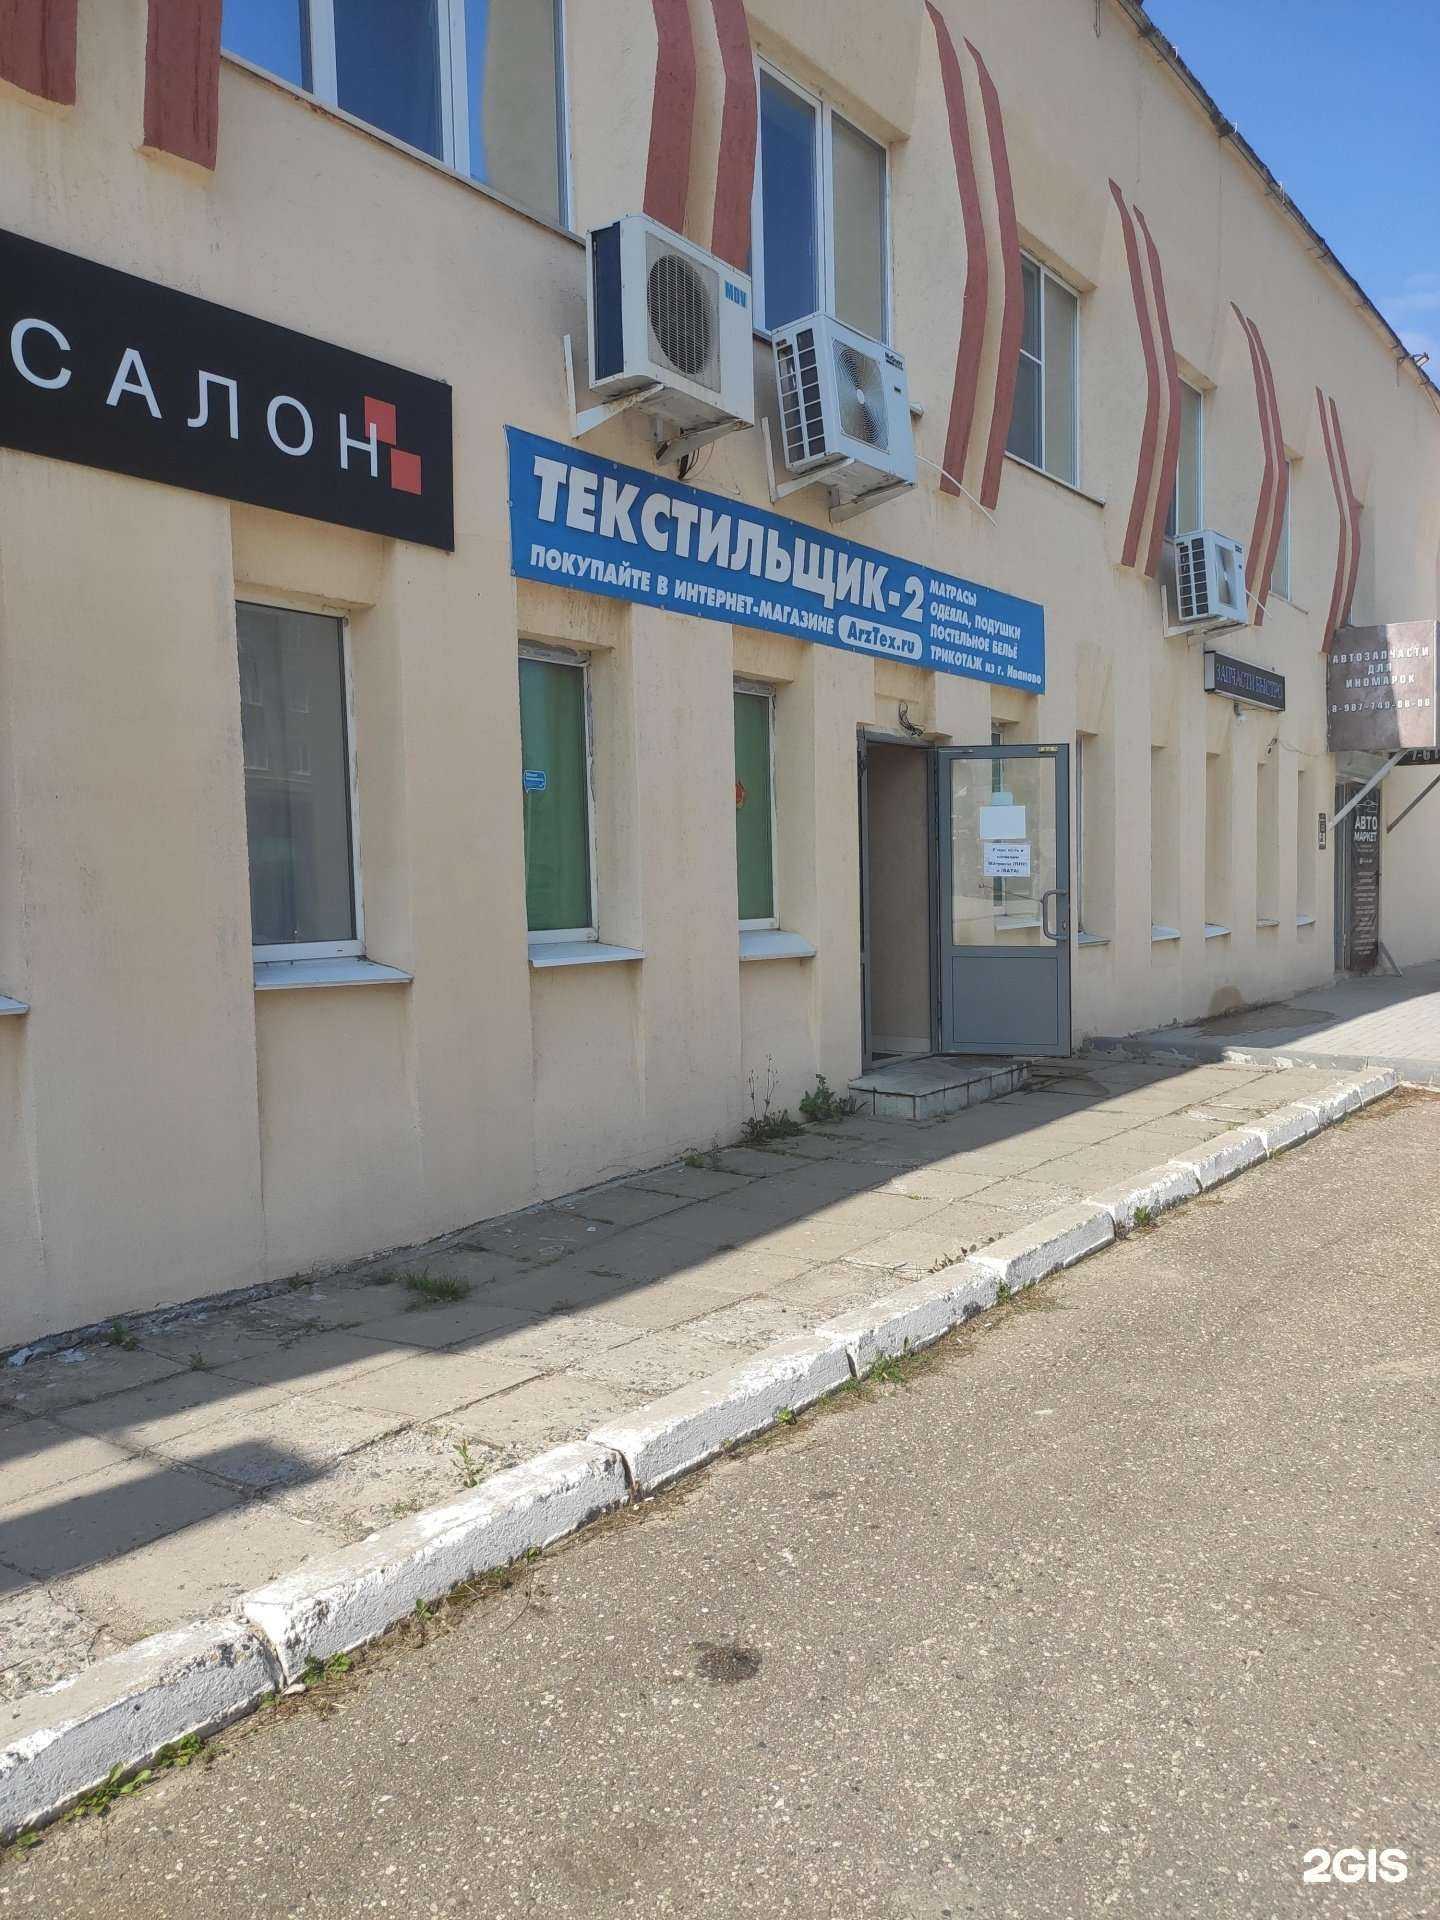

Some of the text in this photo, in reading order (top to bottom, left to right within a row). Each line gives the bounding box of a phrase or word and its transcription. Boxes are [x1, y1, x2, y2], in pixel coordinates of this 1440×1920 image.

[10, 318, 379, 478] САЛОН
[533, 455, 925, 623] ТЕКСТИЛЬЩИК-2
[530, 543, 835, 636] ПОКУПАЙТЕ В ИНТЕРНЕТ-МАГАЗИНЕ
[929, 579, 977, 607] МАТРАСЫ
[930, 602, 1021, 640] ОДЕЯЛА, ПОДУШКИ
[847, 621, 915, 655] ArzTex.ru
[930, 624, 990, 652] ПОСТЕЛЬНОЕ
[930, 645, 1042, 685] ТРИКОТАЖ из г. Иваново
[1332, 647, 1430, 664] АВТОЗАПЧАСТИ
[1345, 675, 1415, 689] ИНОМАРОК
[1353, 832, 1377, 842] МАРКЕТ
[1354, 816, 1378, 830] АВТО
